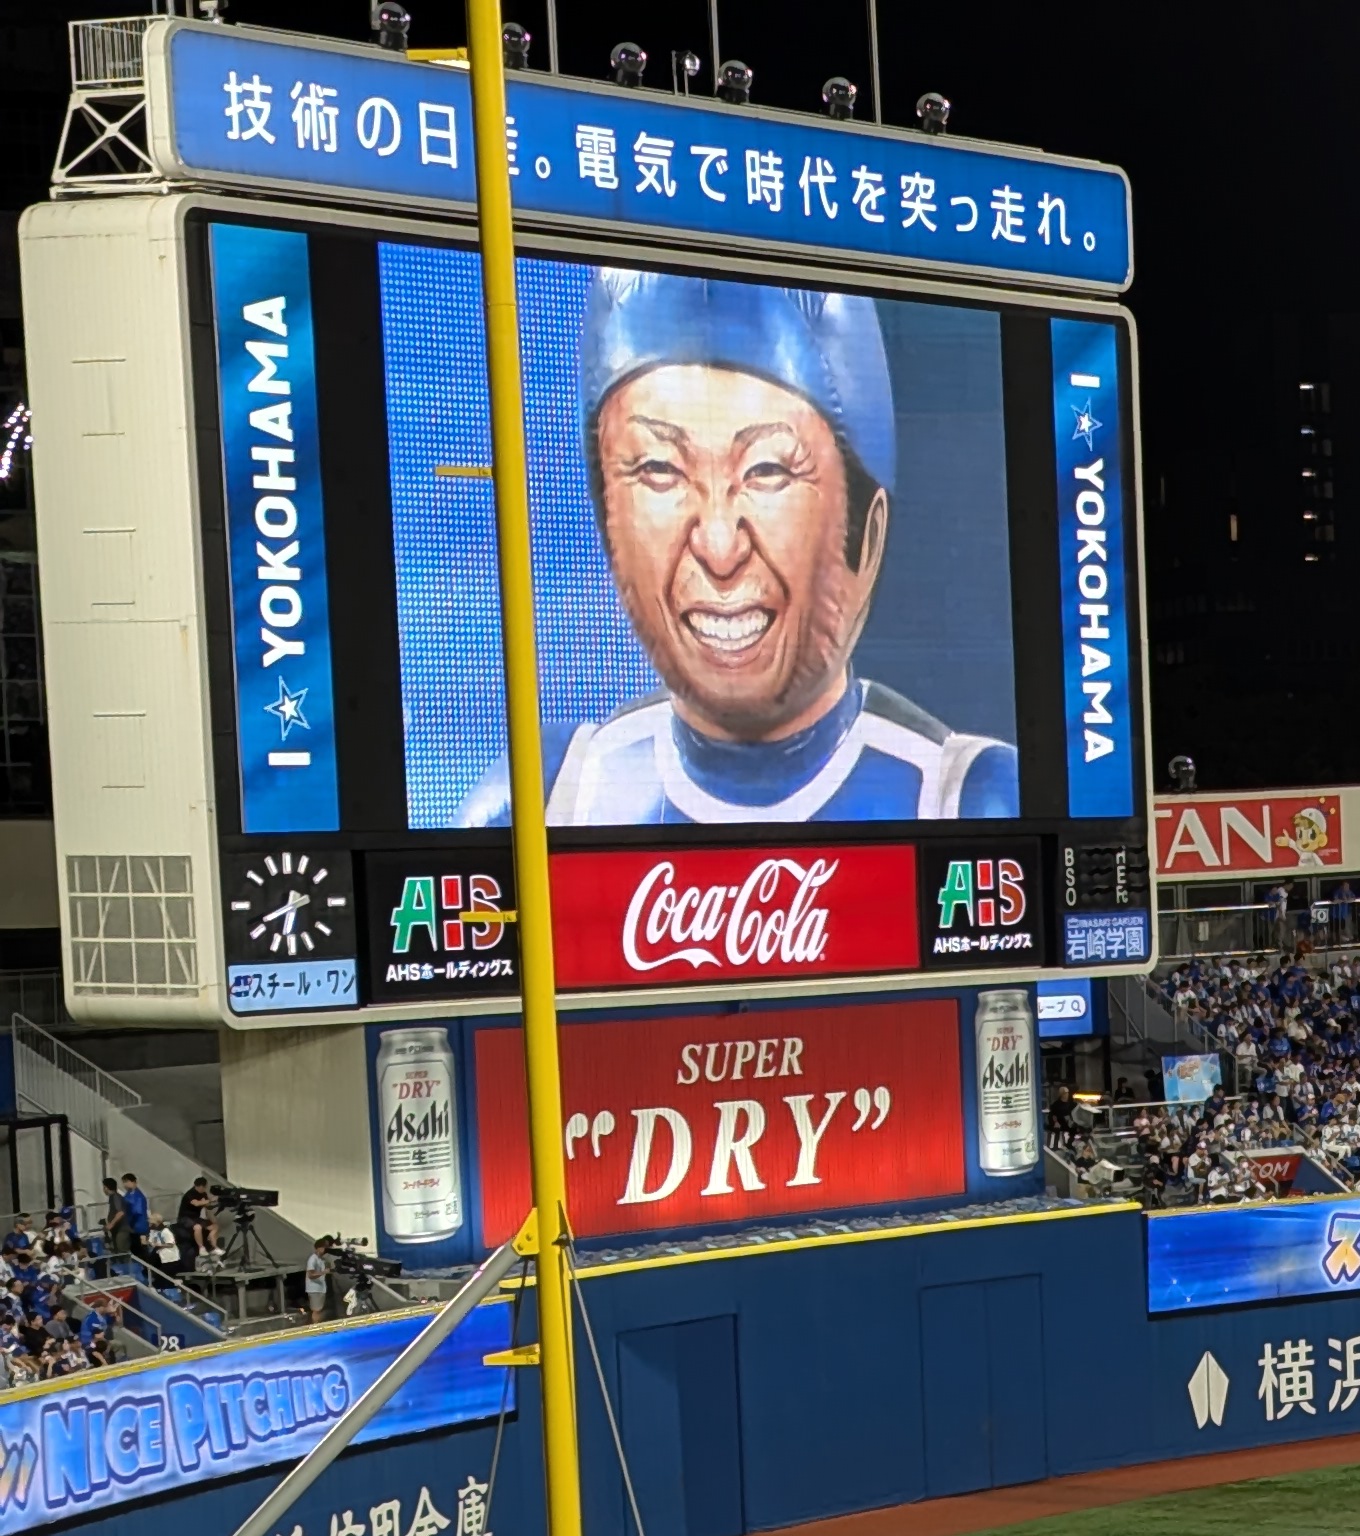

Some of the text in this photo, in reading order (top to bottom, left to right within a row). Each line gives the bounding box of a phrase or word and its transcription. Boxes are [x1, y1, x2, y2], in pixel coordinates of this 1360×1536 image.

[241, 295, 305, 668] YOKOHAMA
[1073, 458, 1115, 763] YOKOHAMA
[1064, 847, 1075, 867] B
[1116, 865, 1128, 884] E
[1065, 867, 1076, 887] S
[622, 857, 840, 972] Coca-Cola
[1065, 887, 1077, 907] O
[933, 933, 1033, 954] AHSホールディングス
[1066, 926, 1145, 961] 岩崎学園
[386, 959, 514, 983] AHSホールディングス
[676, 1036, 806, 1087] SUPER
[982, 1052, 1030, 1090] Asahi
[387, 1100, 449, 1144] Asahi
[41, 1361, 350, 1511] NICE PITCHING
